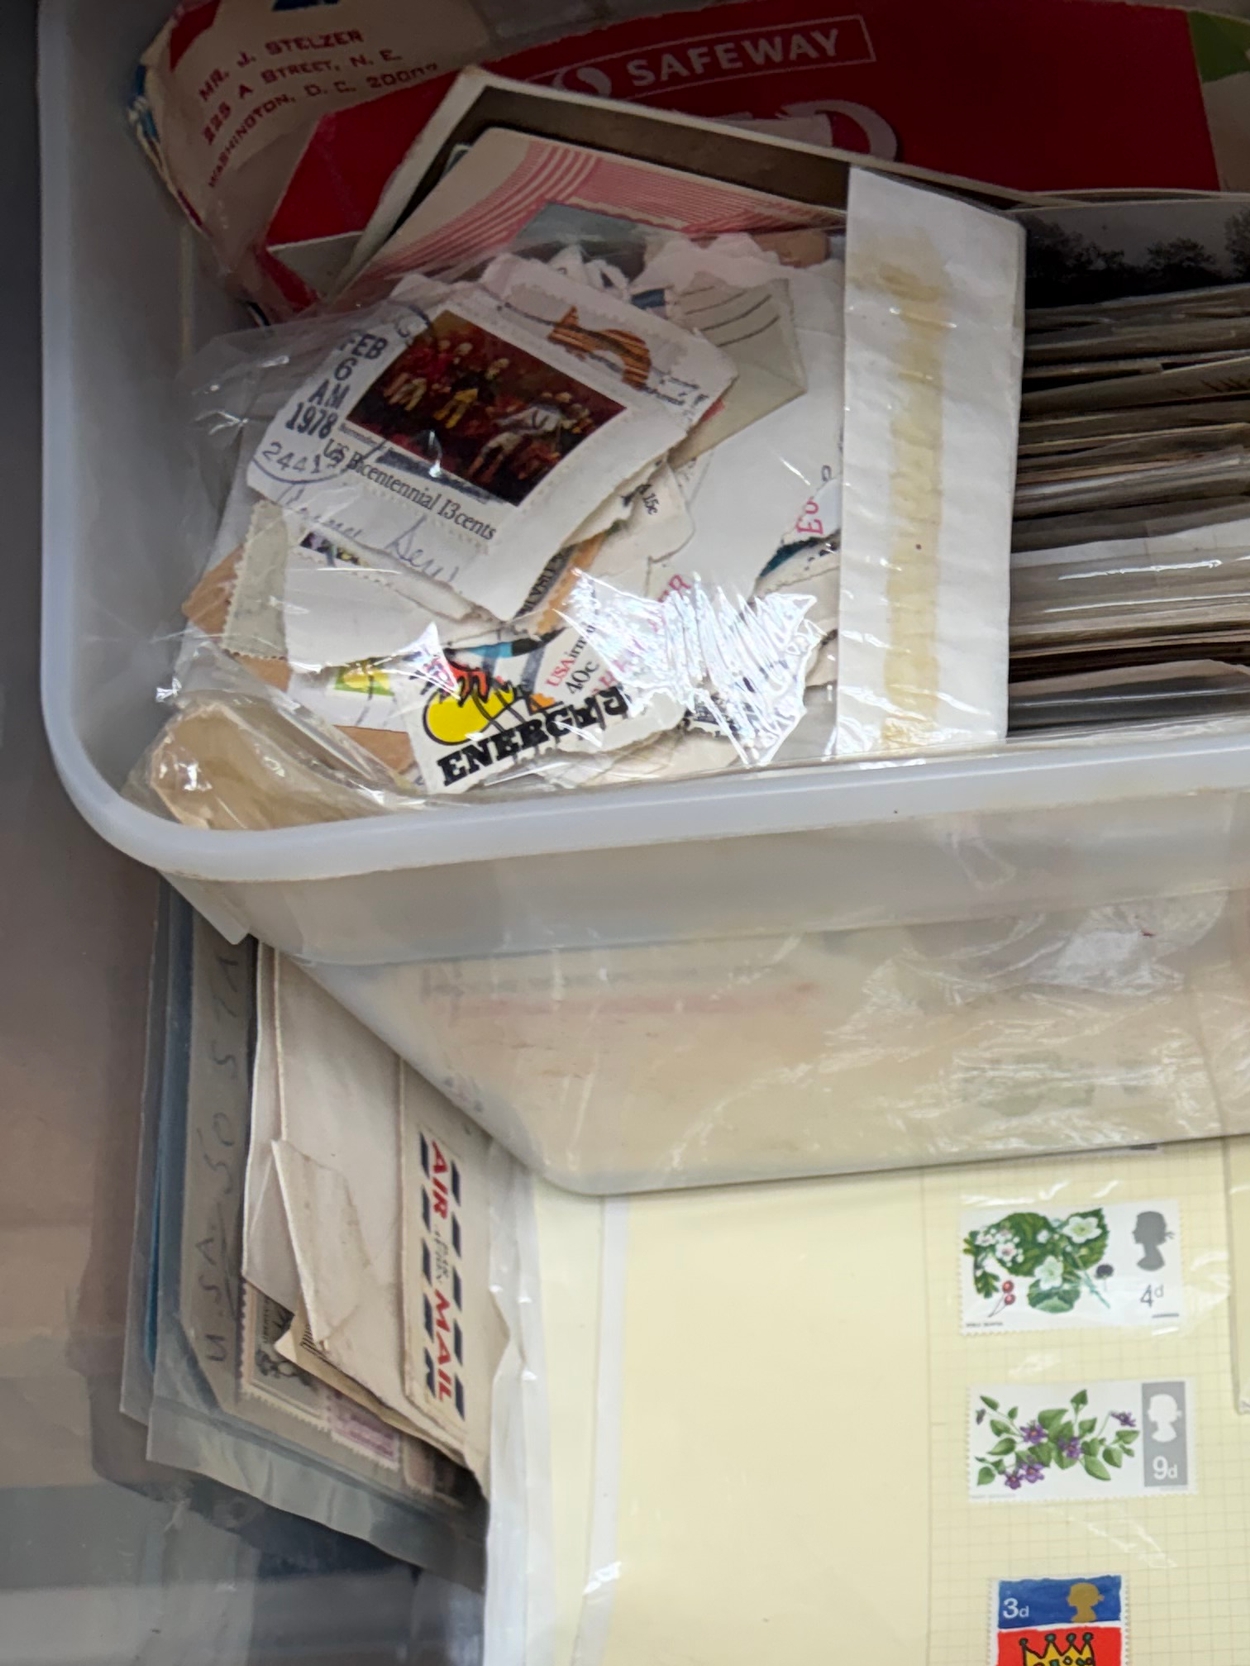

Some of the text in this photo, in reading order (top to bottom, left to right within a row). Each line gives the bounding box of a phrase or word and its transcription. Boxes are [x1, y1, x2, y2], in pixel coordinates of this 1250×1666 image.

[264, 29, 364, 56] STELZER
[625, 28, 840, 88] SAFEWAY
[237, 84, 253, 99] A
[260, 59, 341, 84] STREET,
[334, 357, 357, 381] 6
[308, 379, 350, 410] AM
[285, 402, 338, 440] 1978
[348, 450, 442, 511] Bicentennial
[568, 659, 601, 697] 40c
[431, 1139, 454, 1403] AIR MAIL
[1151, 1455, 1178, 1481] 9d
[1002, 1597, 1030, 1620] 3d
